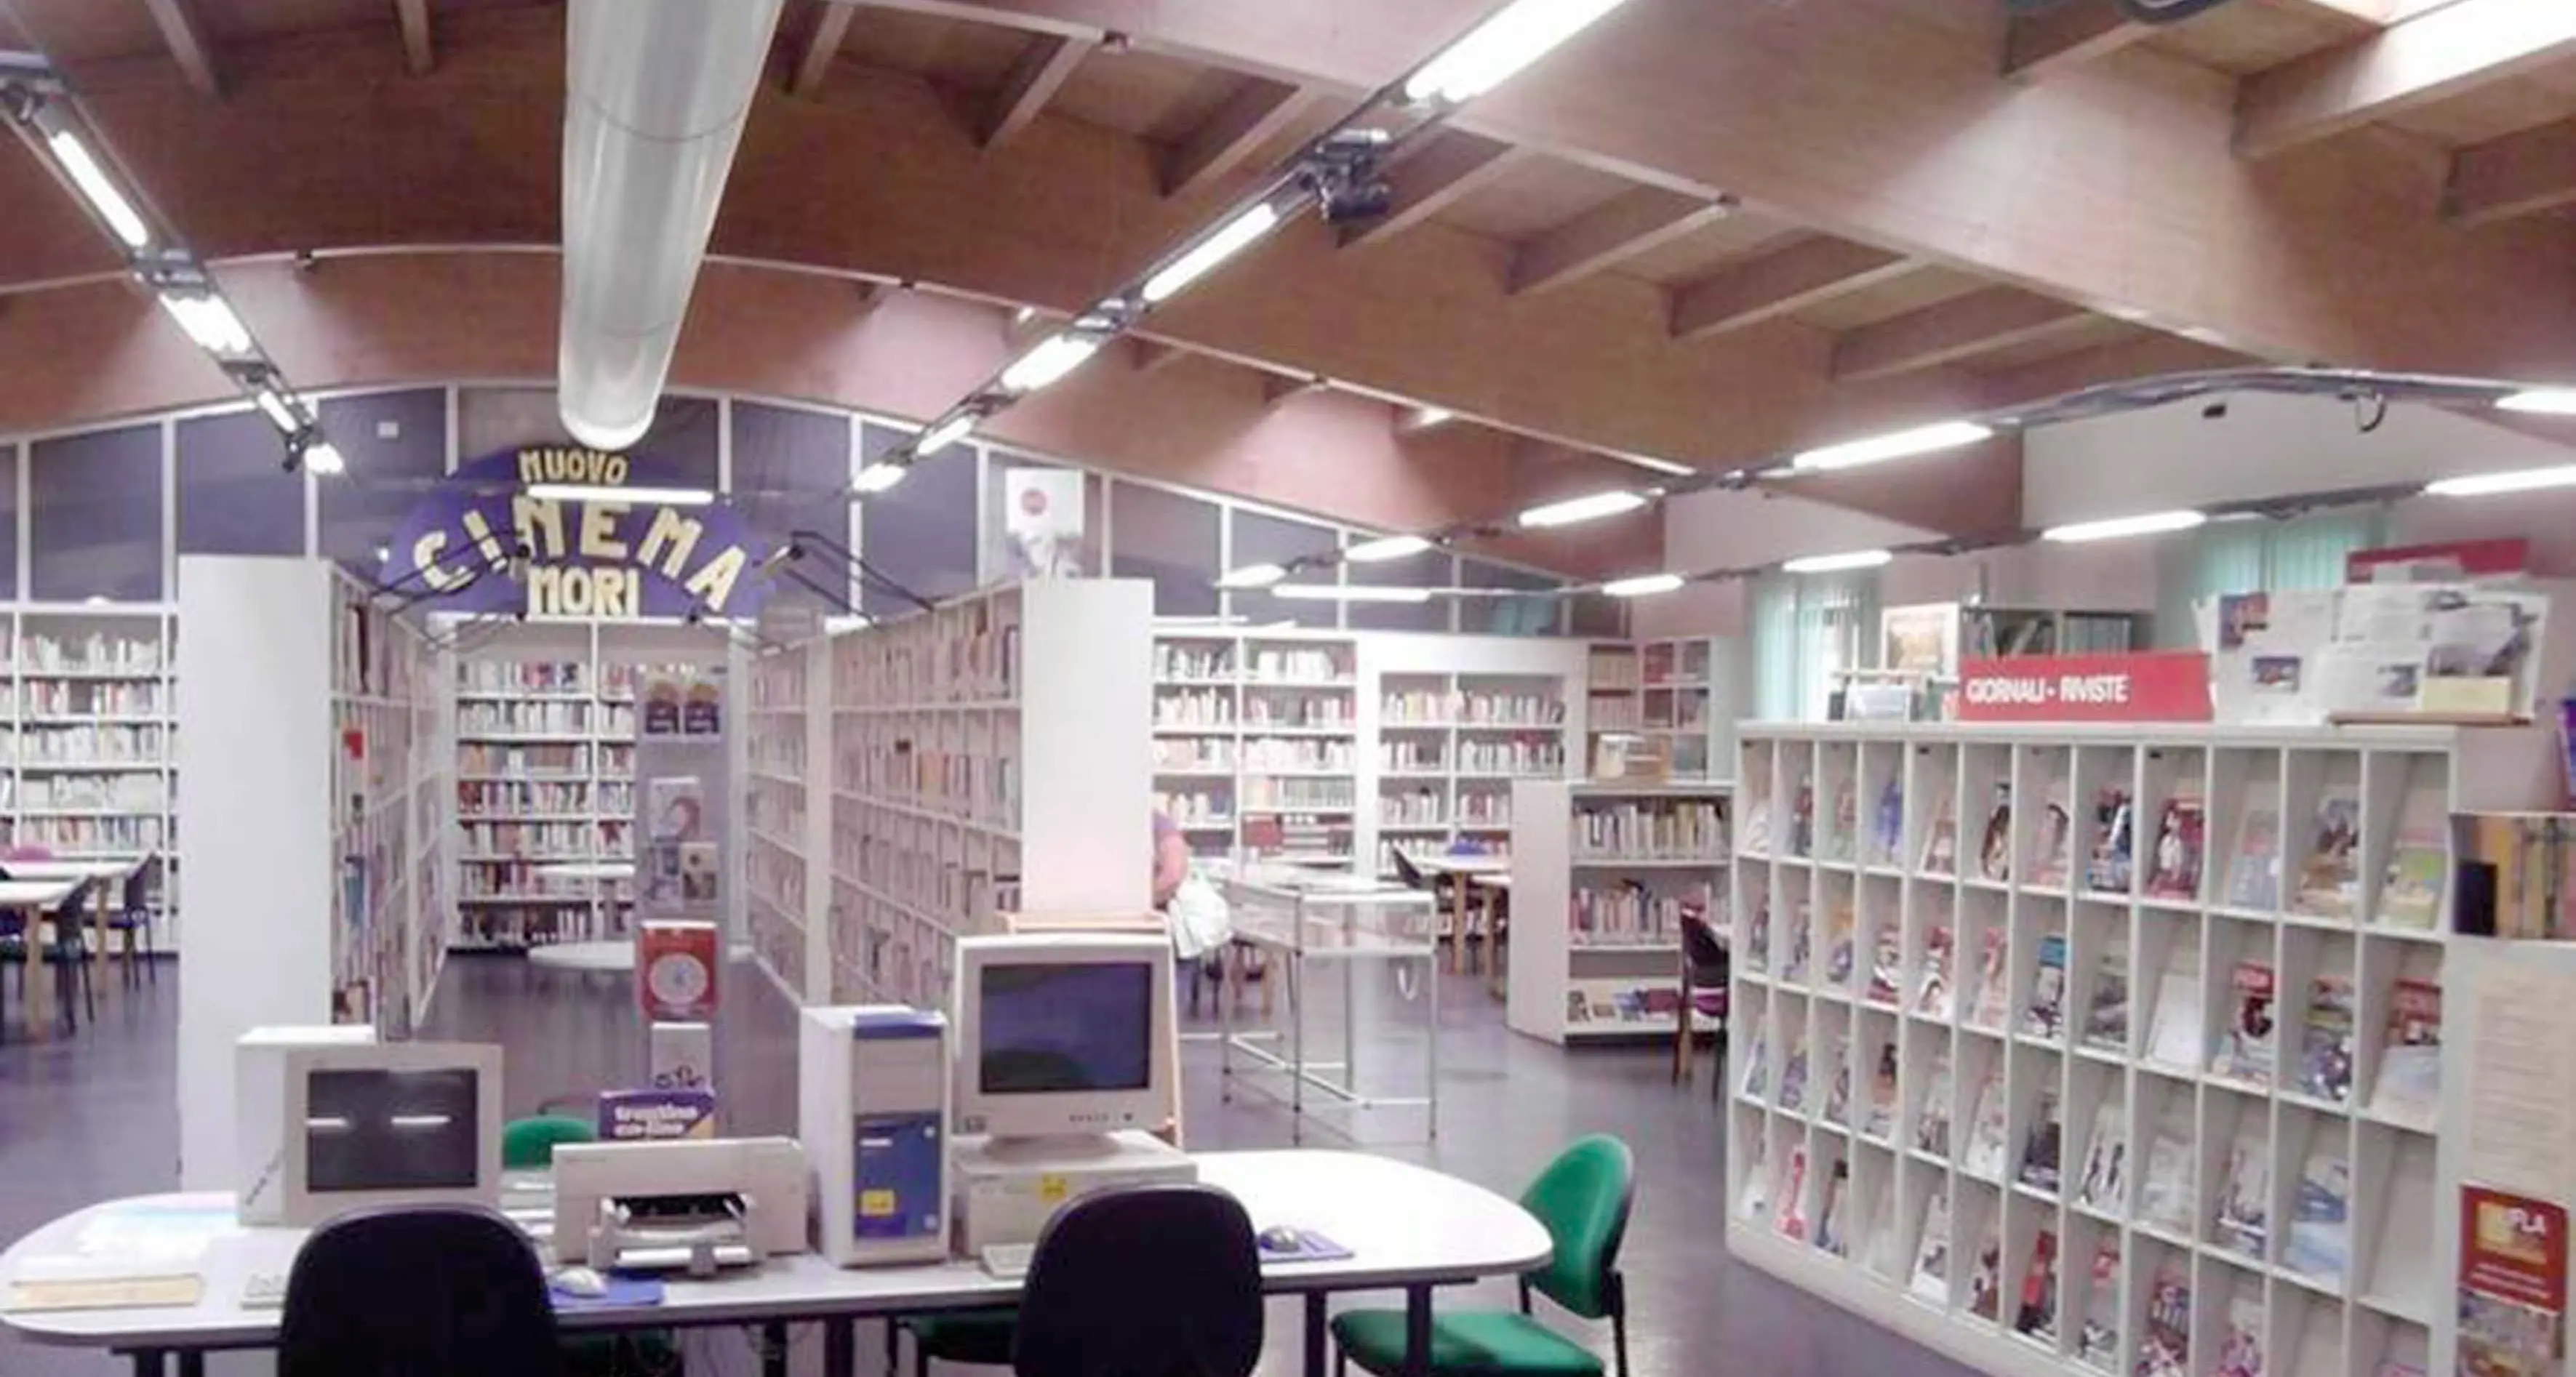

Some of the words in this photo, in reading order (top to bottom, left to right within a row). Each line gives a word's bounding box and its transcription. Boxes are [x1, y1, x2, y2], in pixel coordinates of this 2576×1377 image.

[519, 449, 628, 483] NUOVO
[413, 497, 747, 612] CINEMA
[529, 566, 639, 616] MORI
[1966, 677, 2047, 704] GIORNALI
[2060, 675, 2129, 703] RIVISTE
